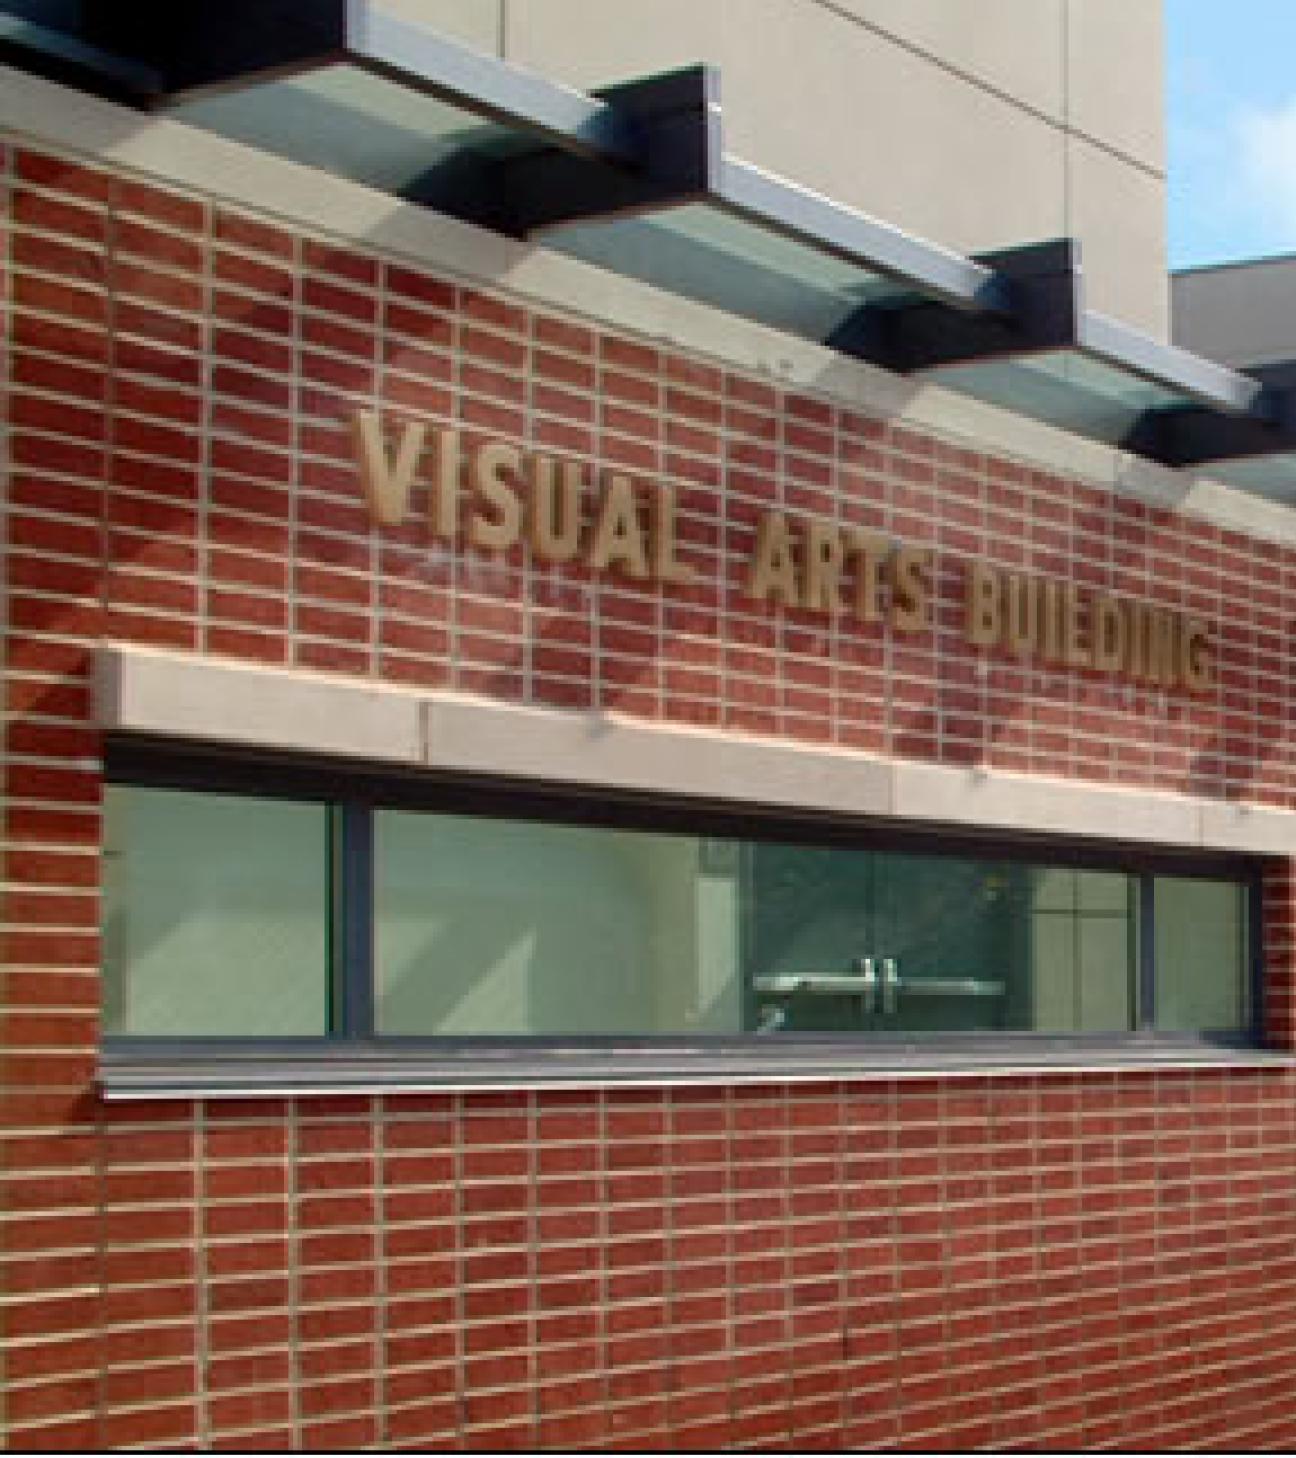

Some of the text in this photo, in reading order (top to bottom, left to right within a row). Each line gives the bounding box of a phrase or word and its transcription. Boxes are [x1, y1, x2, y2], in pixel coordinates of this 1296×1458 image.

[356, 409, 1215, 690] VISUAL ARTS BUILDING
